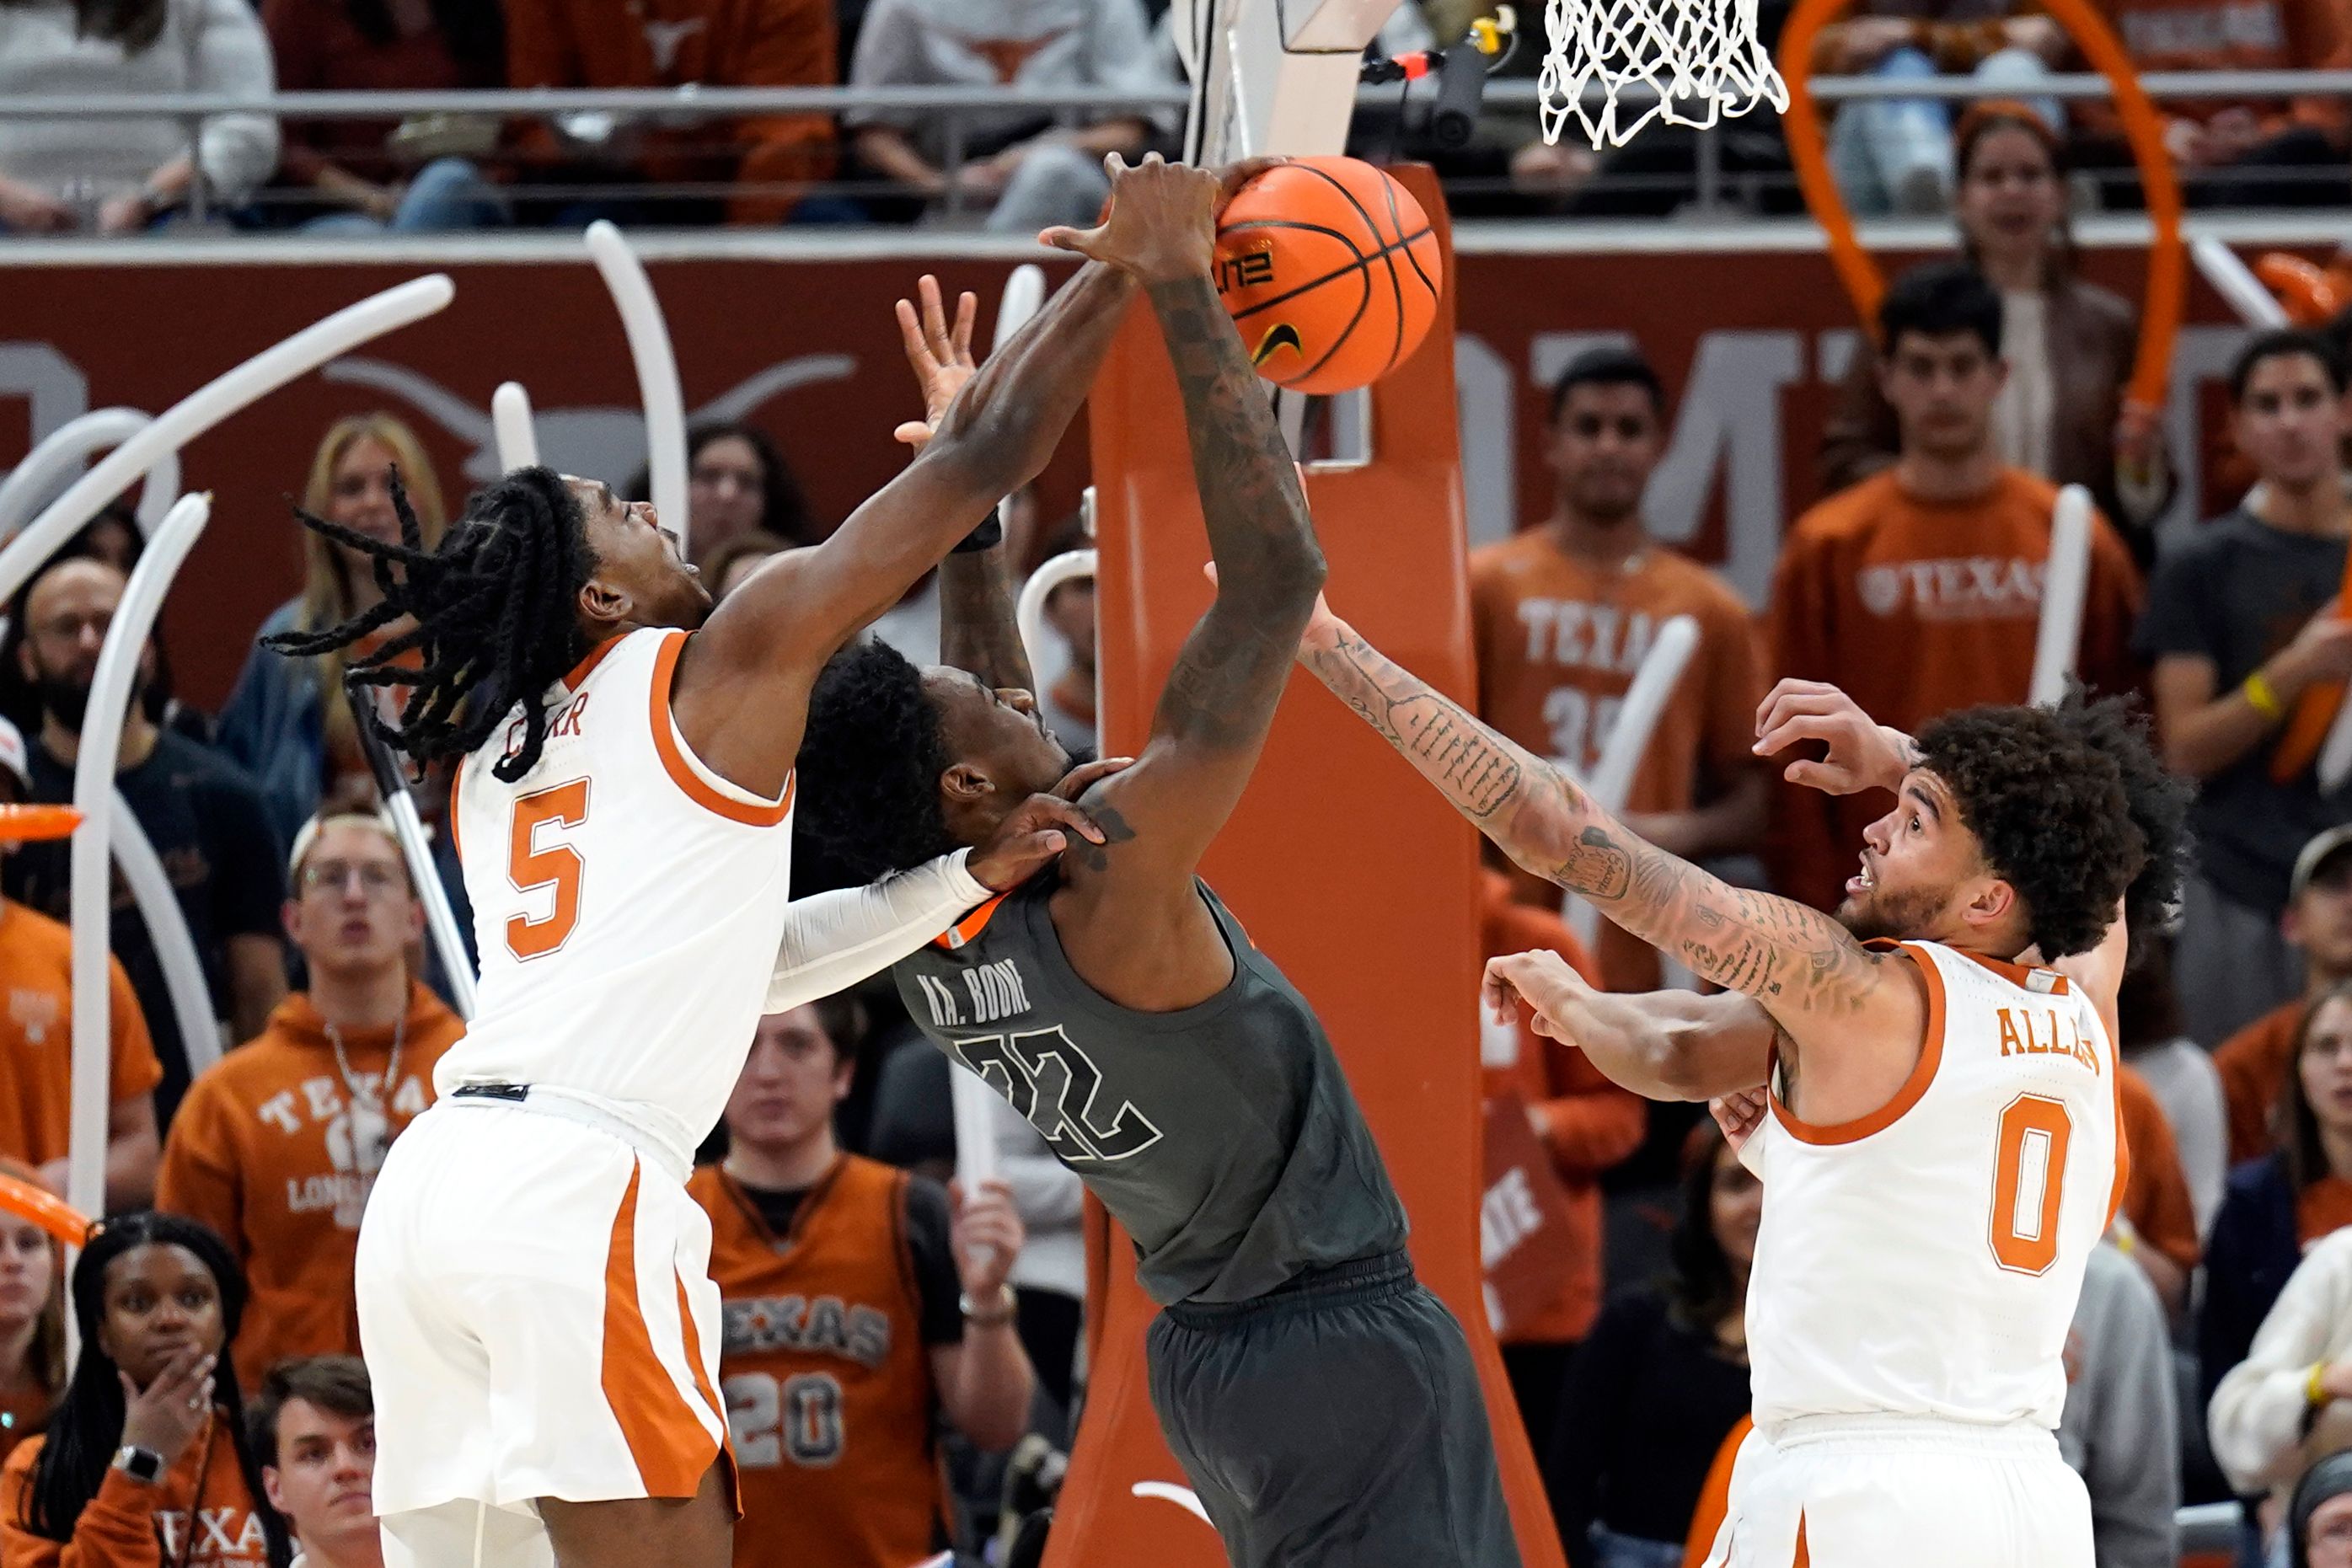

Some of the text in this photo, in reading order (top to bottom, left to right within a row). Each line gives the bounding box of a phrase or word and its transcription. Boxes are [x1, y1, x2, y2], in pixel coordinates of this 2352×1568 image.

[1903, 557, 2053, 602] TEXA
[505, 775, 591, 962] 5
[1987, 1091, 2073, 1277] 0
[722, 1295, 892, 1369] EXAS
[723, 1372, 844, 1466] 20
